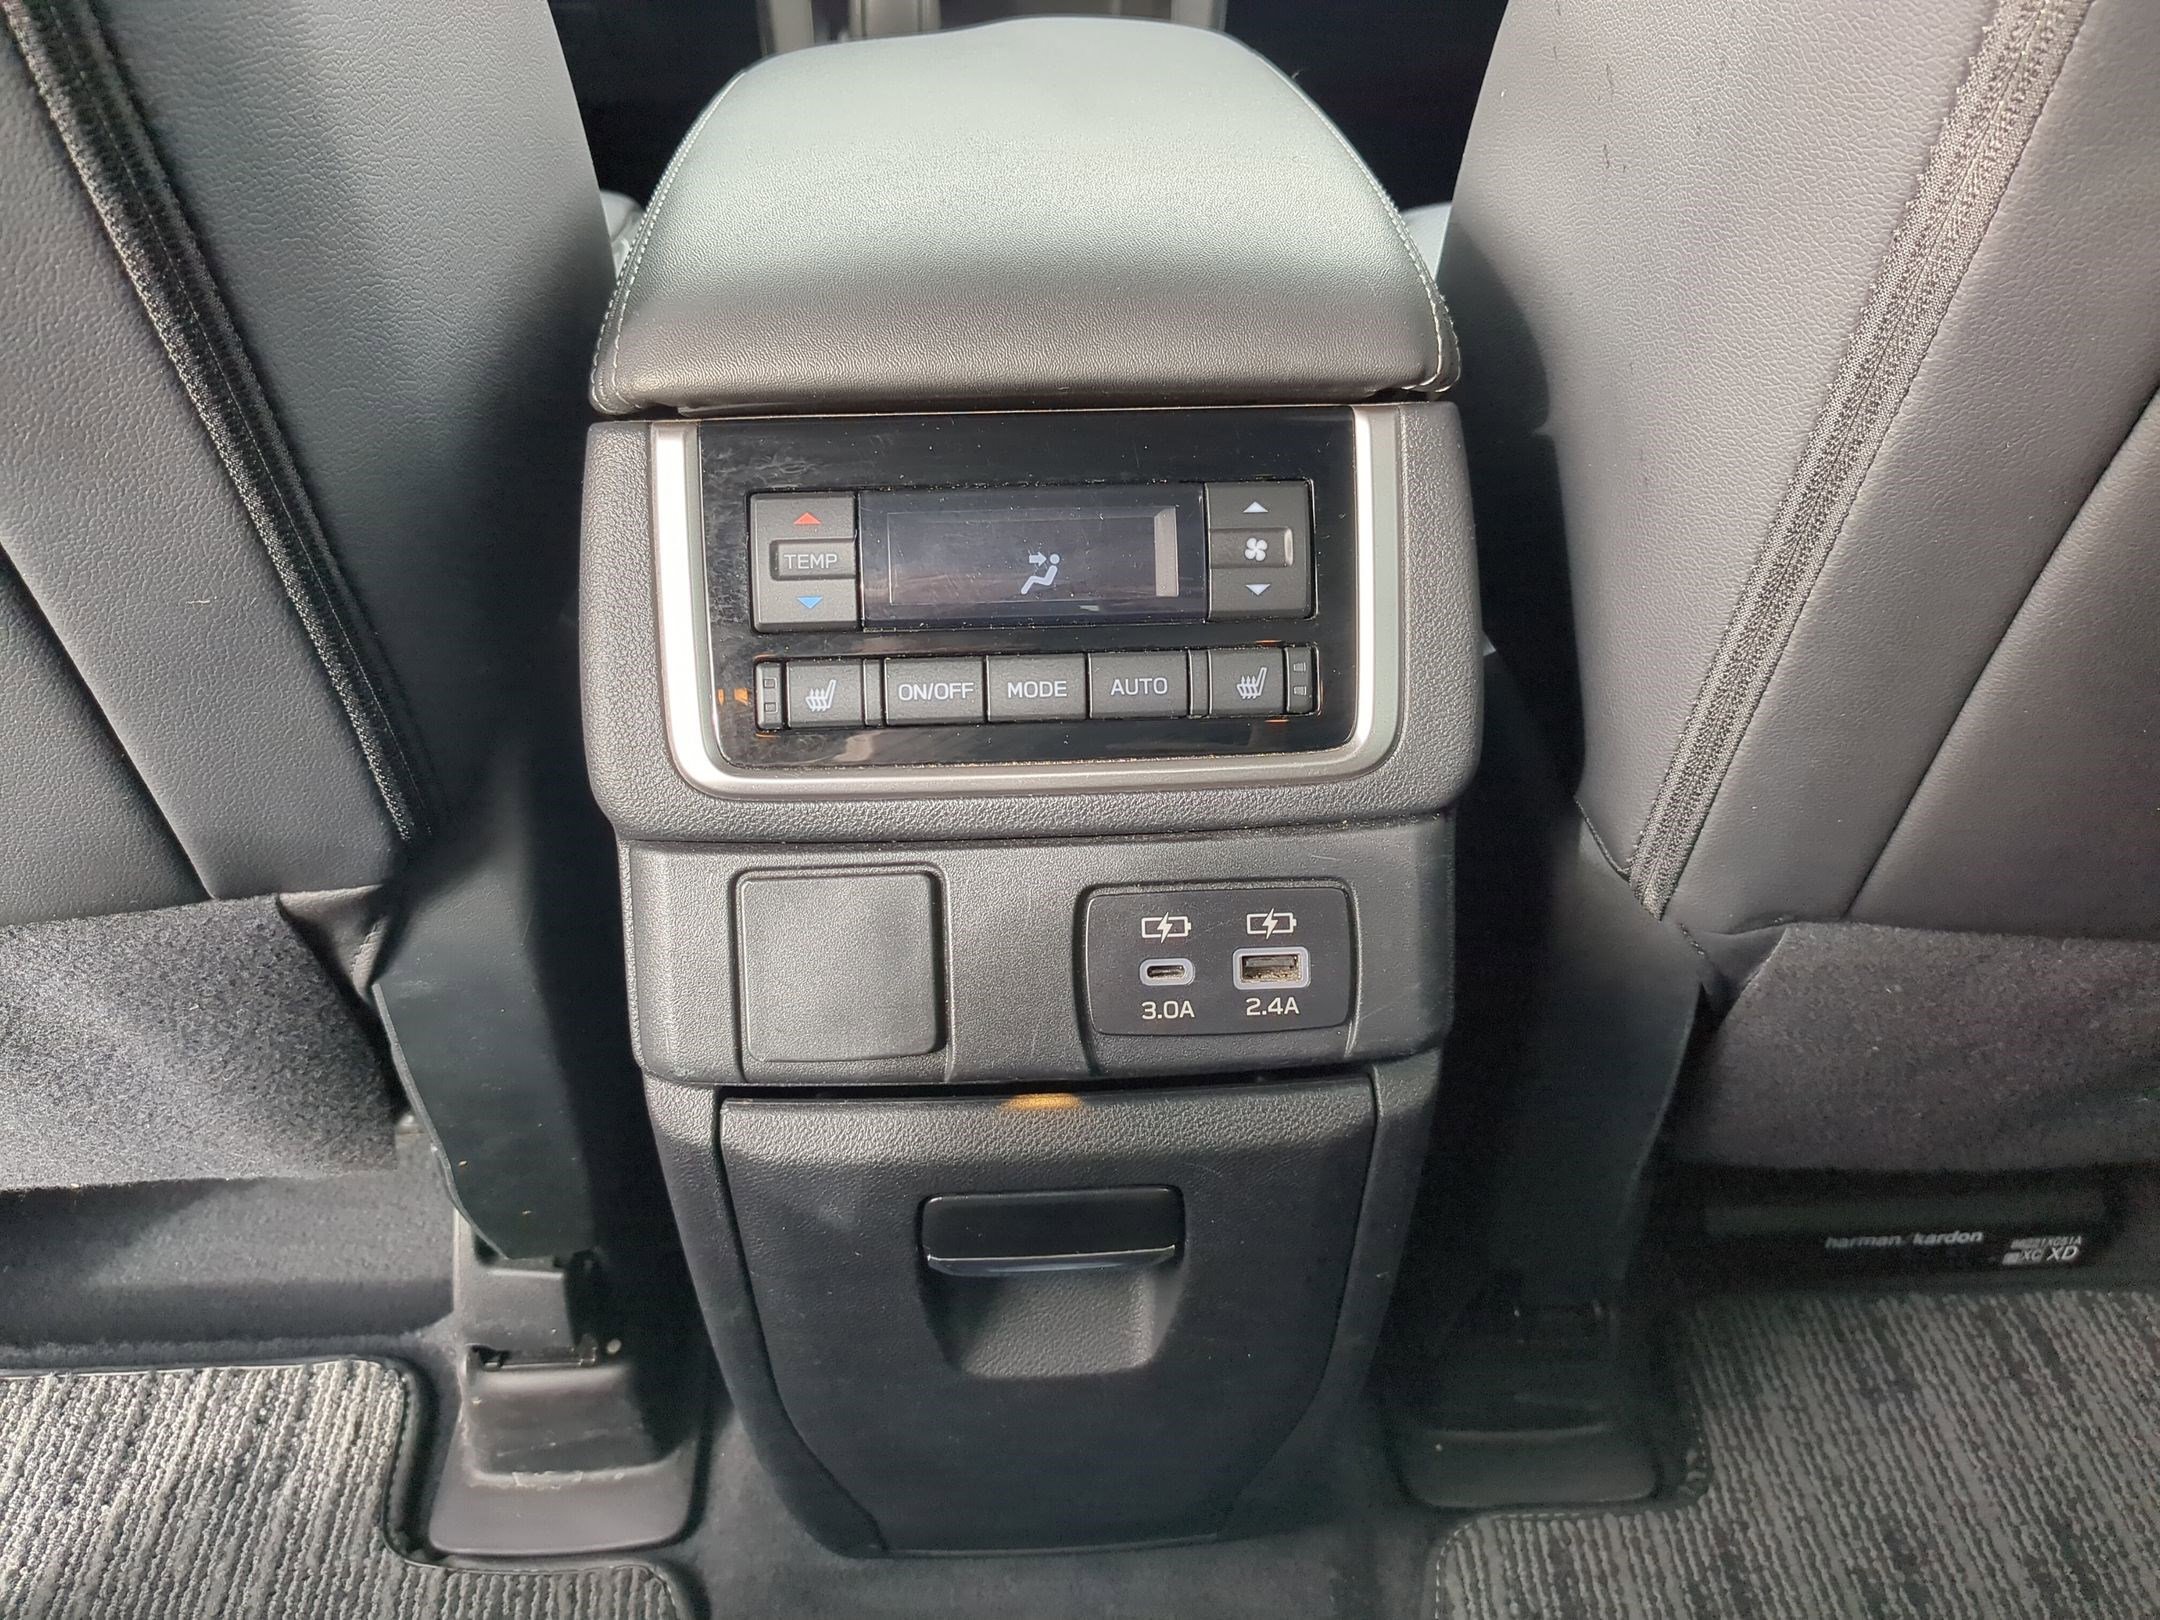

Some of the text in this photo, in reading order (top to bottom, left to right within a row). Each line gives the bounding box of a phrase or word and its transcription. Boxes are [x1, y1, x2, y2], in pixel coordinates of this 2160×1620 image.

[783, 551, 838, 569] TEMP
[897, 681, 975, 701] ON/OFF
[1006, 680, 1068, 699] MODE
[1109, 677, 1169, 696] AUTO
[1141, 1000, 1195, 1020] 3.0A
[1246, 996, 1300, 1016] 2.4A
[1825, 1230, 1984, 1249] harman kardon
[2047, 1245, 2079, 1262] XD
